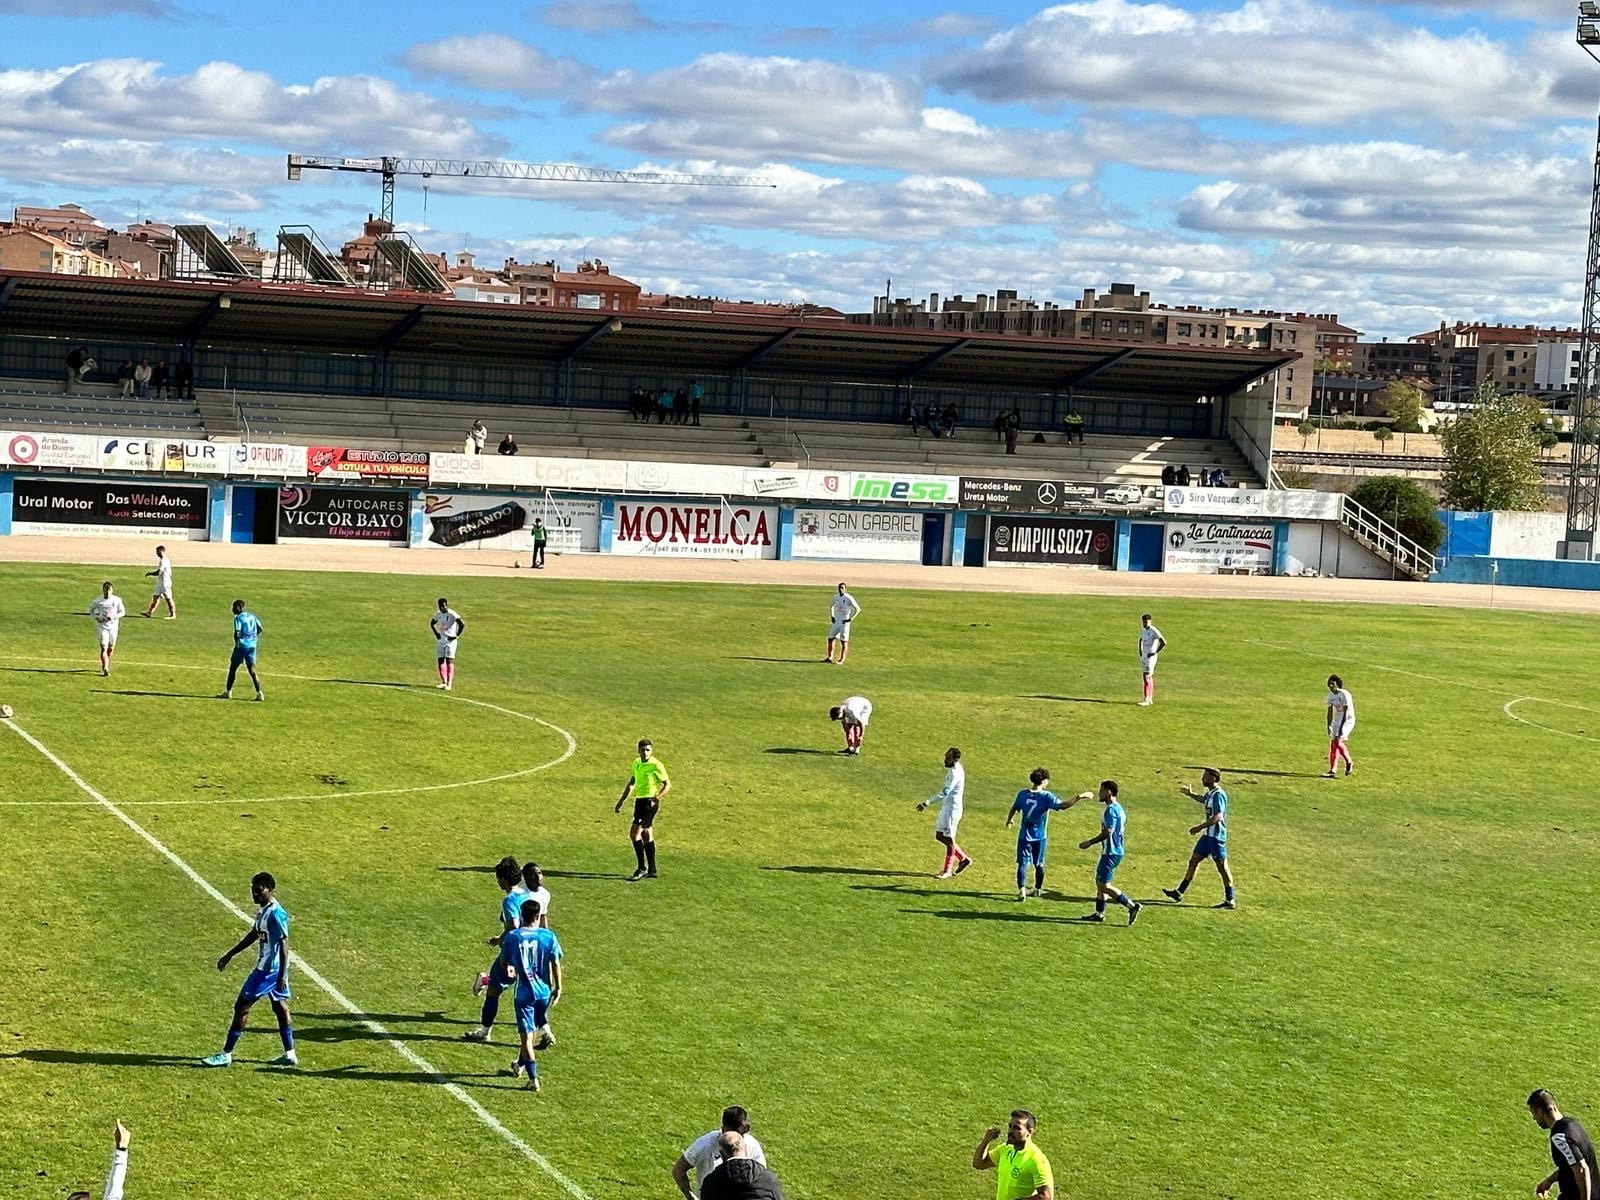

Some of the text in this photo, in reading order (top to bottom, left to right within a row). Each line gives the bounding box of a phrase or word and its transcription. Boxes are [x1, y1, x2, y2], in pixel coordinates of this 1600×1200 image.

[347, 450, 398, 462] ESTUDIO
[399, 453, 427, 464] 1200
[337, 463, 370, 472] ROTULA
[386, 464, 427, 474] VEHÍCULO
[852, 474, 948, 501] imesa
[964, 481, 1022, 492] Mercedes-Benz
[19, 495, 94, 510] Ural Motor
[964, 492, 984, 501] Ureta
[986, 494, 1009, 502] Motor
[1189, 492, 1206, 503] Siro
[1245, 495, 1260, 505] S.L.
[328, 499, 404, 511] AUTOCARES
[132, 510, 176, 520] Selection
[284, 511, 403, 528] VICTOR BAYO
[618, 506, 772, 546] MONELCA
[828, 513, 919, 533] SAN GABRIEL
[329, 527, 338, 536] El
[338, 528, 354, 536] lujo
[1186, 524, 1273, 540] La Cantinaccia
[1012, 526, 1092, 554] IMPULSO27
[1026, 798, 1038, 818] 7
[518, 939, 538, 970] 11
